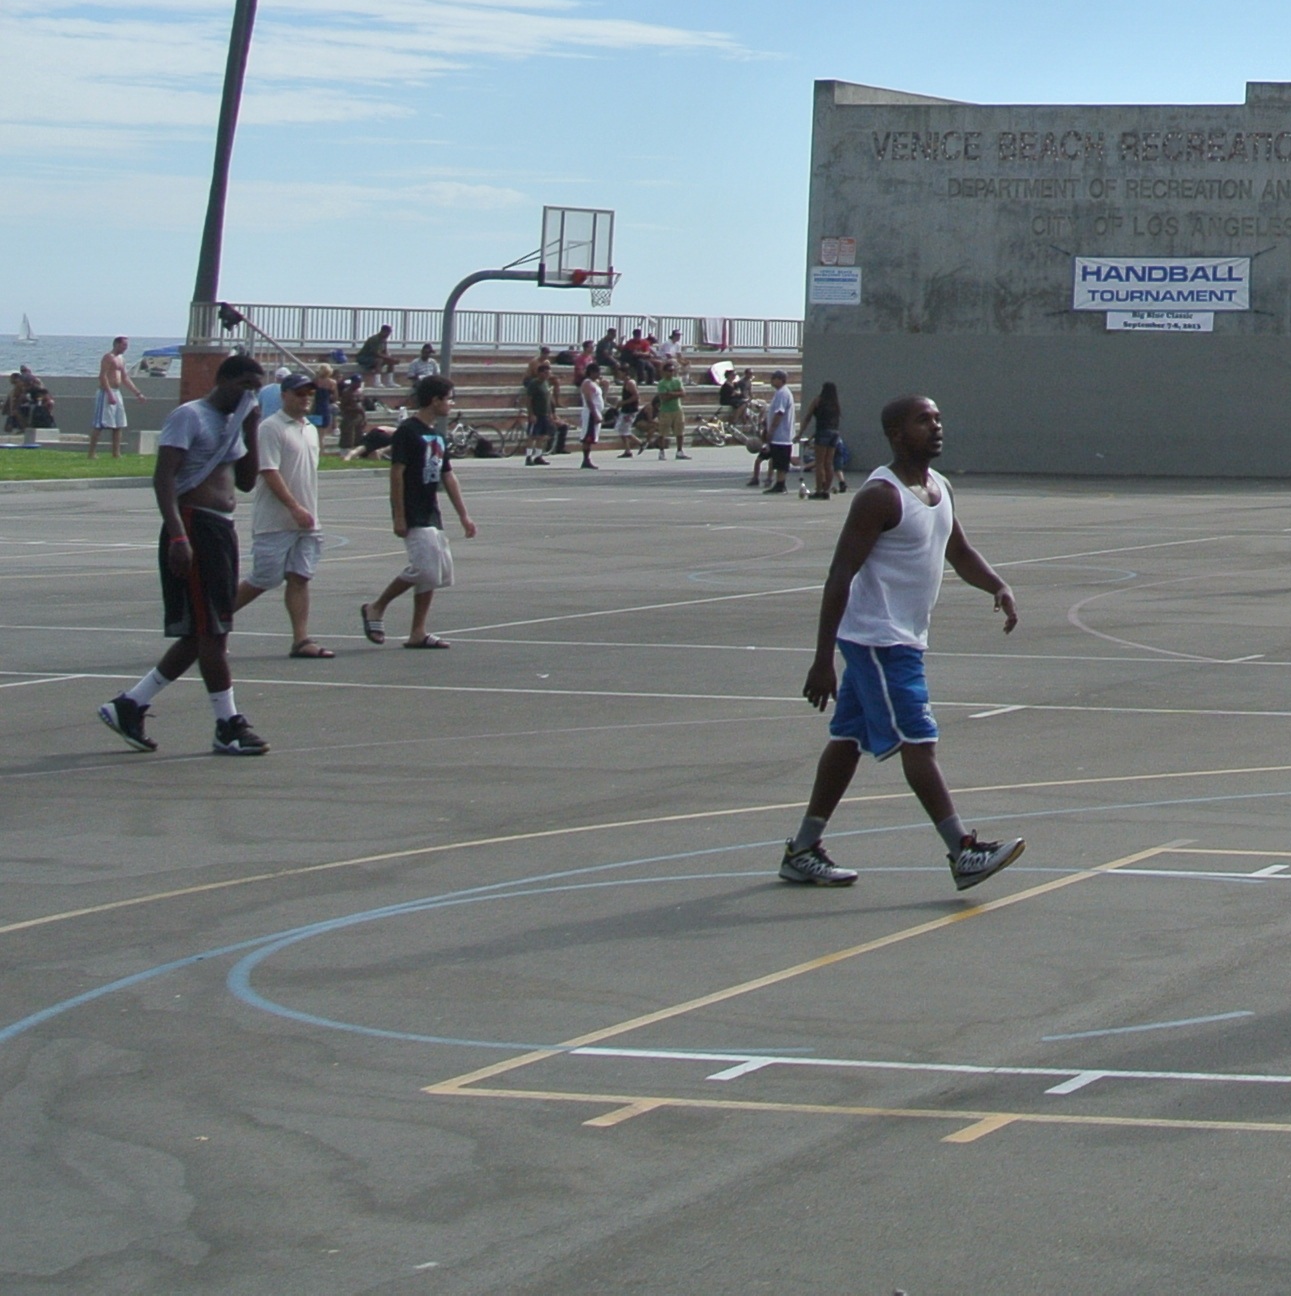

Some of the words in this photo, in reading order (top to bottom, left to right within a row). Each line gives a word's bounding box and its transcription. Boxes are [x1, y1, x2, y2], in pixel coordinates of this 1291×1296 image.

[872, 131, 982, 161] VENICE
[999, 131, 1104, 161] BEACH
[948, 178, 1082, 199] DEPARTMENT
[1089, 179, 1117, 199] OF
[1126, 179, 1253, 200] RECREATION
[1031, 215, 1080, 236] CITY
[1094, 216, 1123, 236] OF
[1133, 216, 1179, 237] LOS
[1082, 266, 1243, 282] HANDBALL
[1087, 289, 1237, 302] TOURNAMENT
[1123, 321, 1165, 329] September
